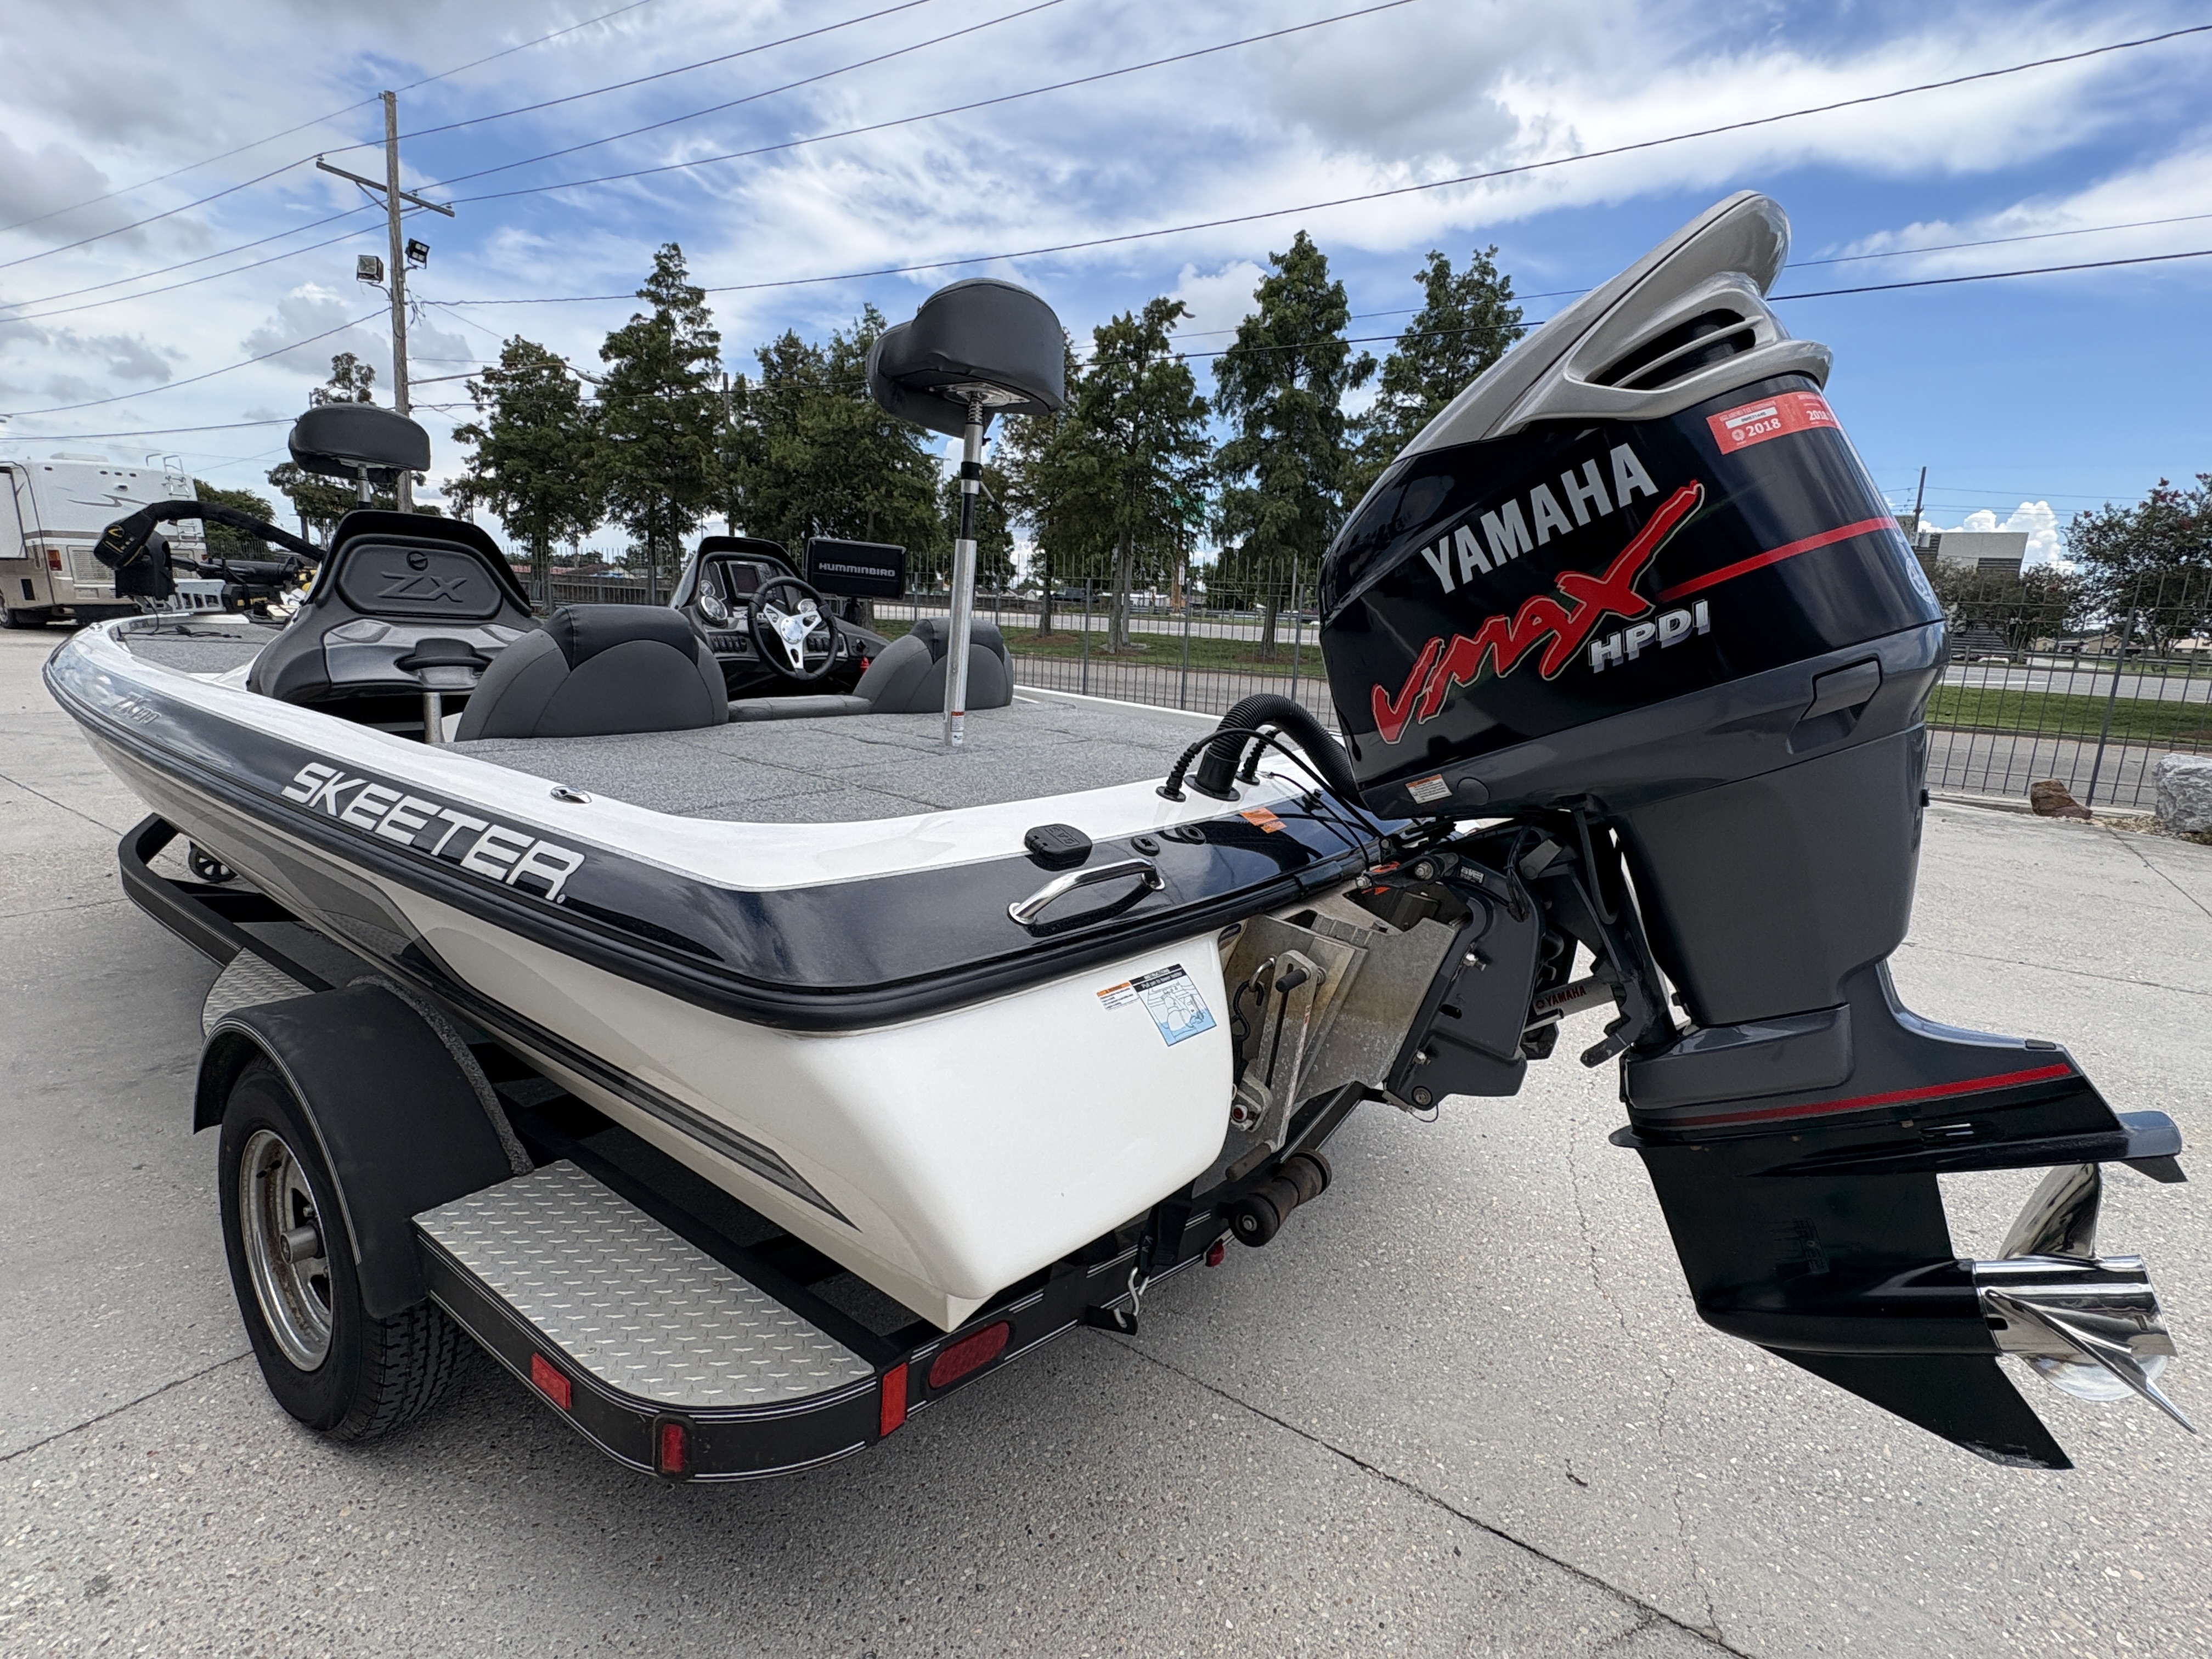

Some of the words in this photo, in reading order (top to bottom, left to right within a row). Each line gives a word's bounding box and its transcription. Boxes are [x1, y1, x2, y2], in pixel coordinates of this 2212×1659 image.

[1745, 418, 1781, 437] 2018
[1420, 442, 1660, 594] YAMAHA
[819, 562, 896, 577] HUMMINBIRD
[377, 571, 467, 603] ZX
[1589, 599, 1711, 674] HPDI
[280, 761, 585, 901] SKEETER
[1545, 985, 1587, 1007] YAMAHA
